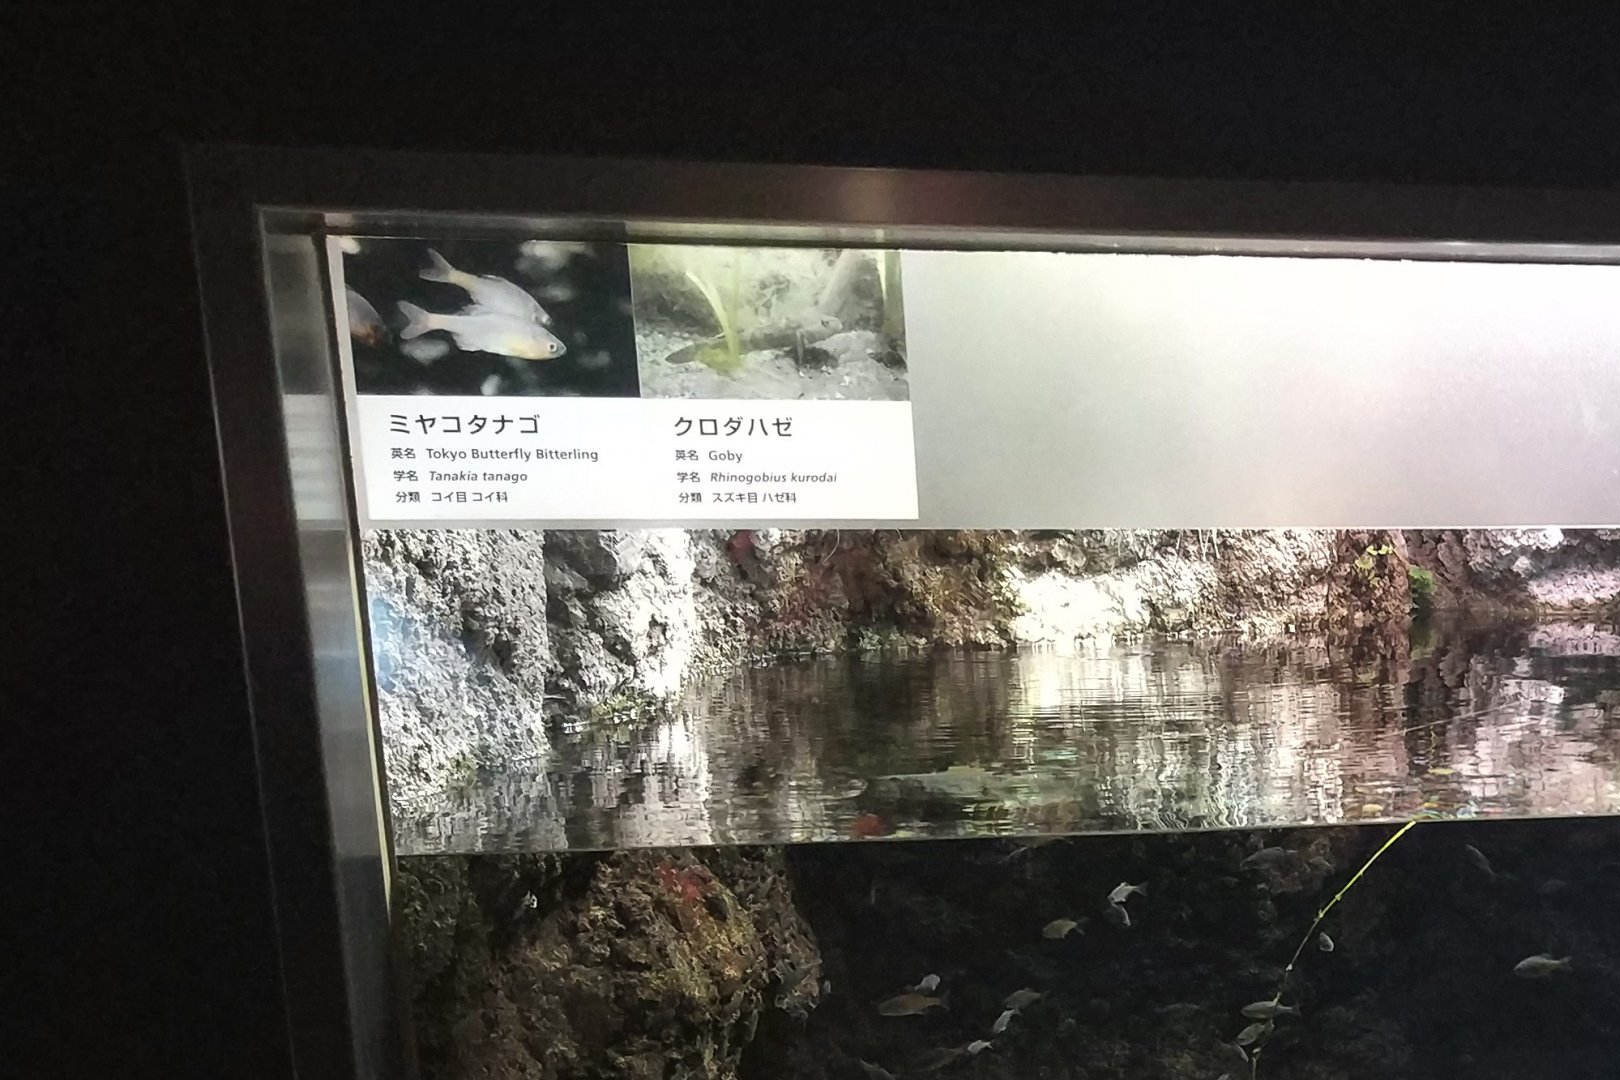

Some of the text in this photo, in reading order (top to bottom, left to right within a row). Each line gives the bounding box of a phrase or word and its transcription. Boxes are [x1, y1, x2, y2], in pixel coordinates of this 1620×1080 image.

[390, 414, 540, 435] ミヤコタナゴ
[674, 416, 793, 437] クロダハゼ
[391, 448, 599, 462] 英名 Tokyo Butterfly Bitterling
[675, 449, 743, 463] 英名 Goby
[393, 470, 528, 483] 学名 Tanakia tanago
[677, 472, 837, 484] 学名 Rhinogobius kurodai
[395, 491, 508, 503] 分類 コイ目 コイ科
[678, 492, 796, 503] 分類 スズキ目 ハゼ科
